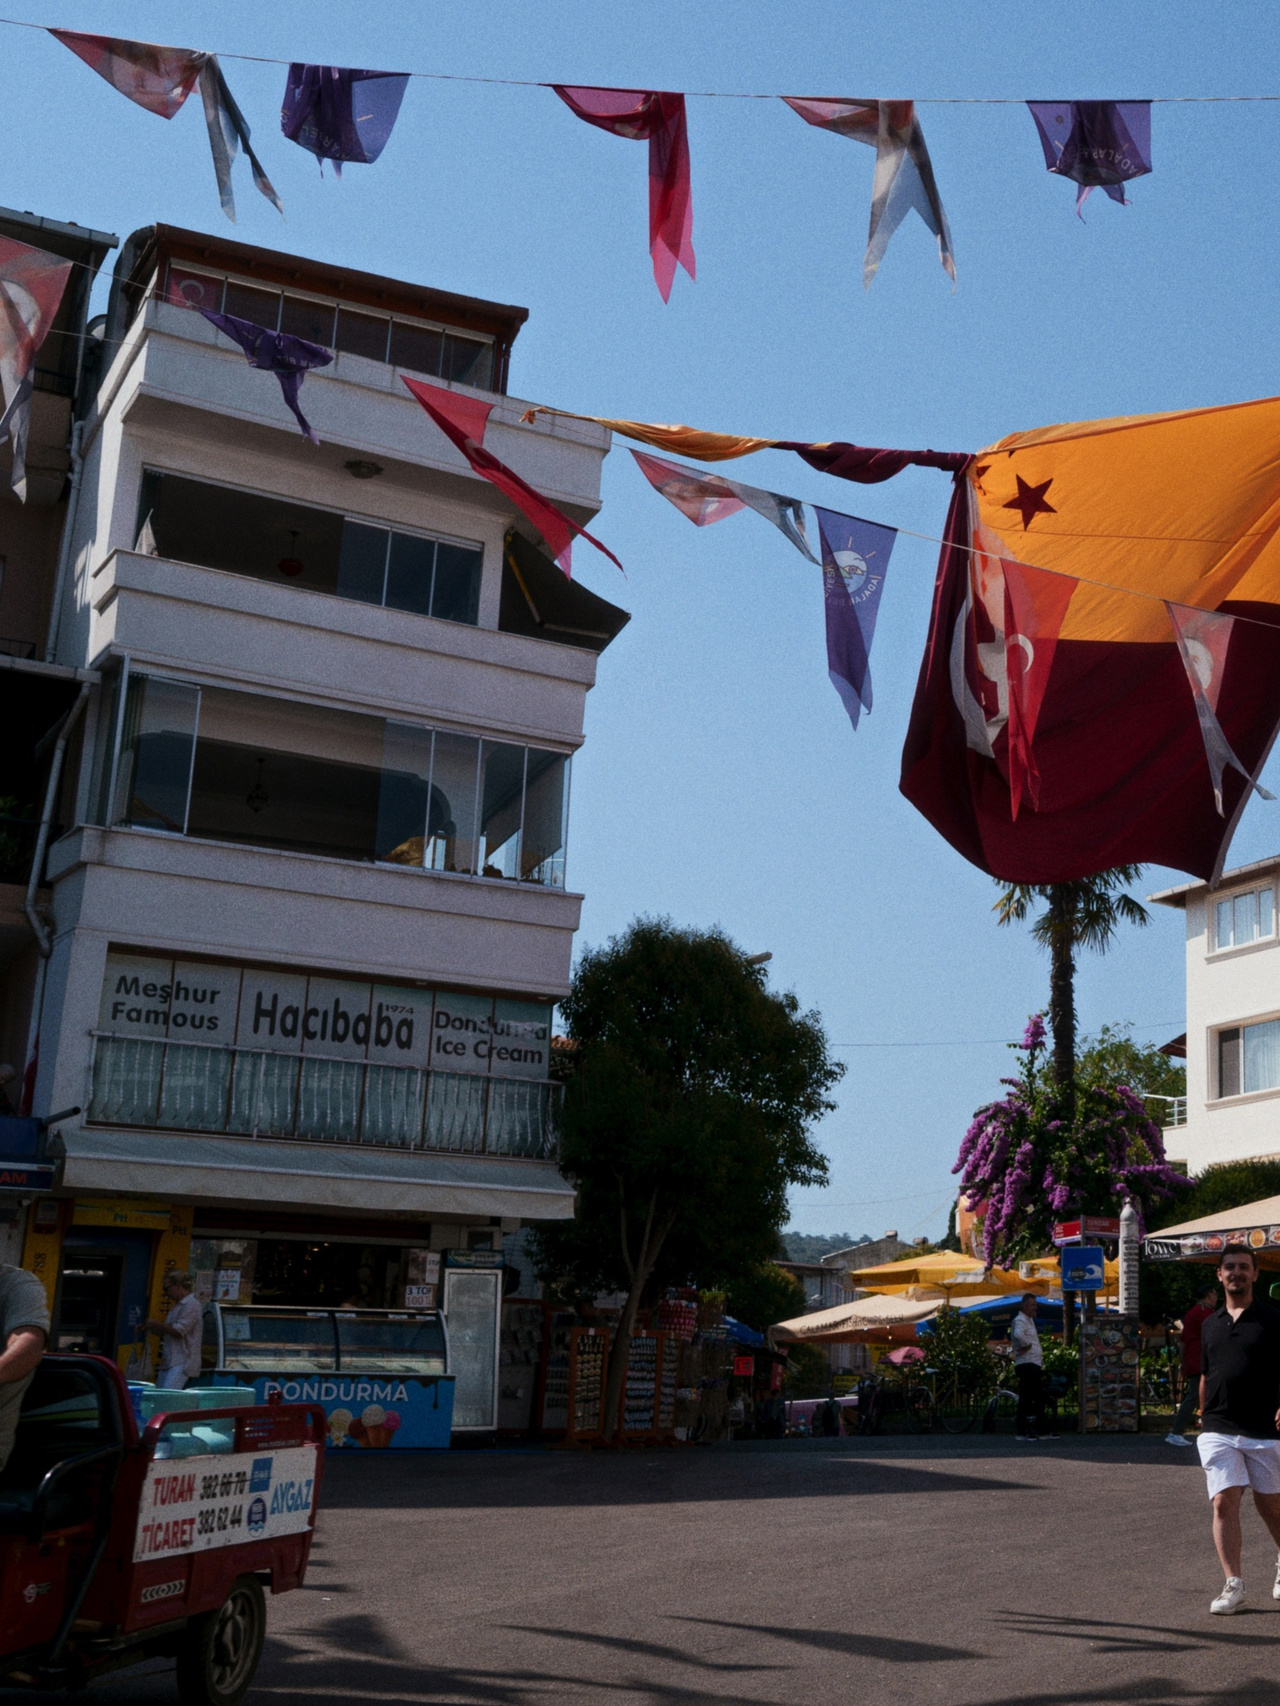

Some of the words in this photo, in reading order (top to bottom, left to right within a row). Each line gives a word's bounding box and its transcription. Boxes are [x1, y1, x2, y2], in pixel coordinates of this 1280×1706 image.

[115, 975, 220, 1004] Meşhur
[111, 1001, 220, 1031] Famous
[253, 991, 414, 1050] Hacıbaba
[385, 1003, 415, 1015] 1974
[436, 1035, 467, 1057] Ice
[473, 1039, 544, 1064] Cream
[407, 1286, 413, 1295] 3
[153, 1473, 196, 1506] TURAN
[199, 1474, 219, 1501] 382
[270, 1479, 314, 1516] AYGAZ
[141, 1516, 196, 1555] TİCARET
[197, 1508, 216, 1536] 382
[216, 1506, 229, 1531] 62
[229, 1503, 244, 1529] 44
